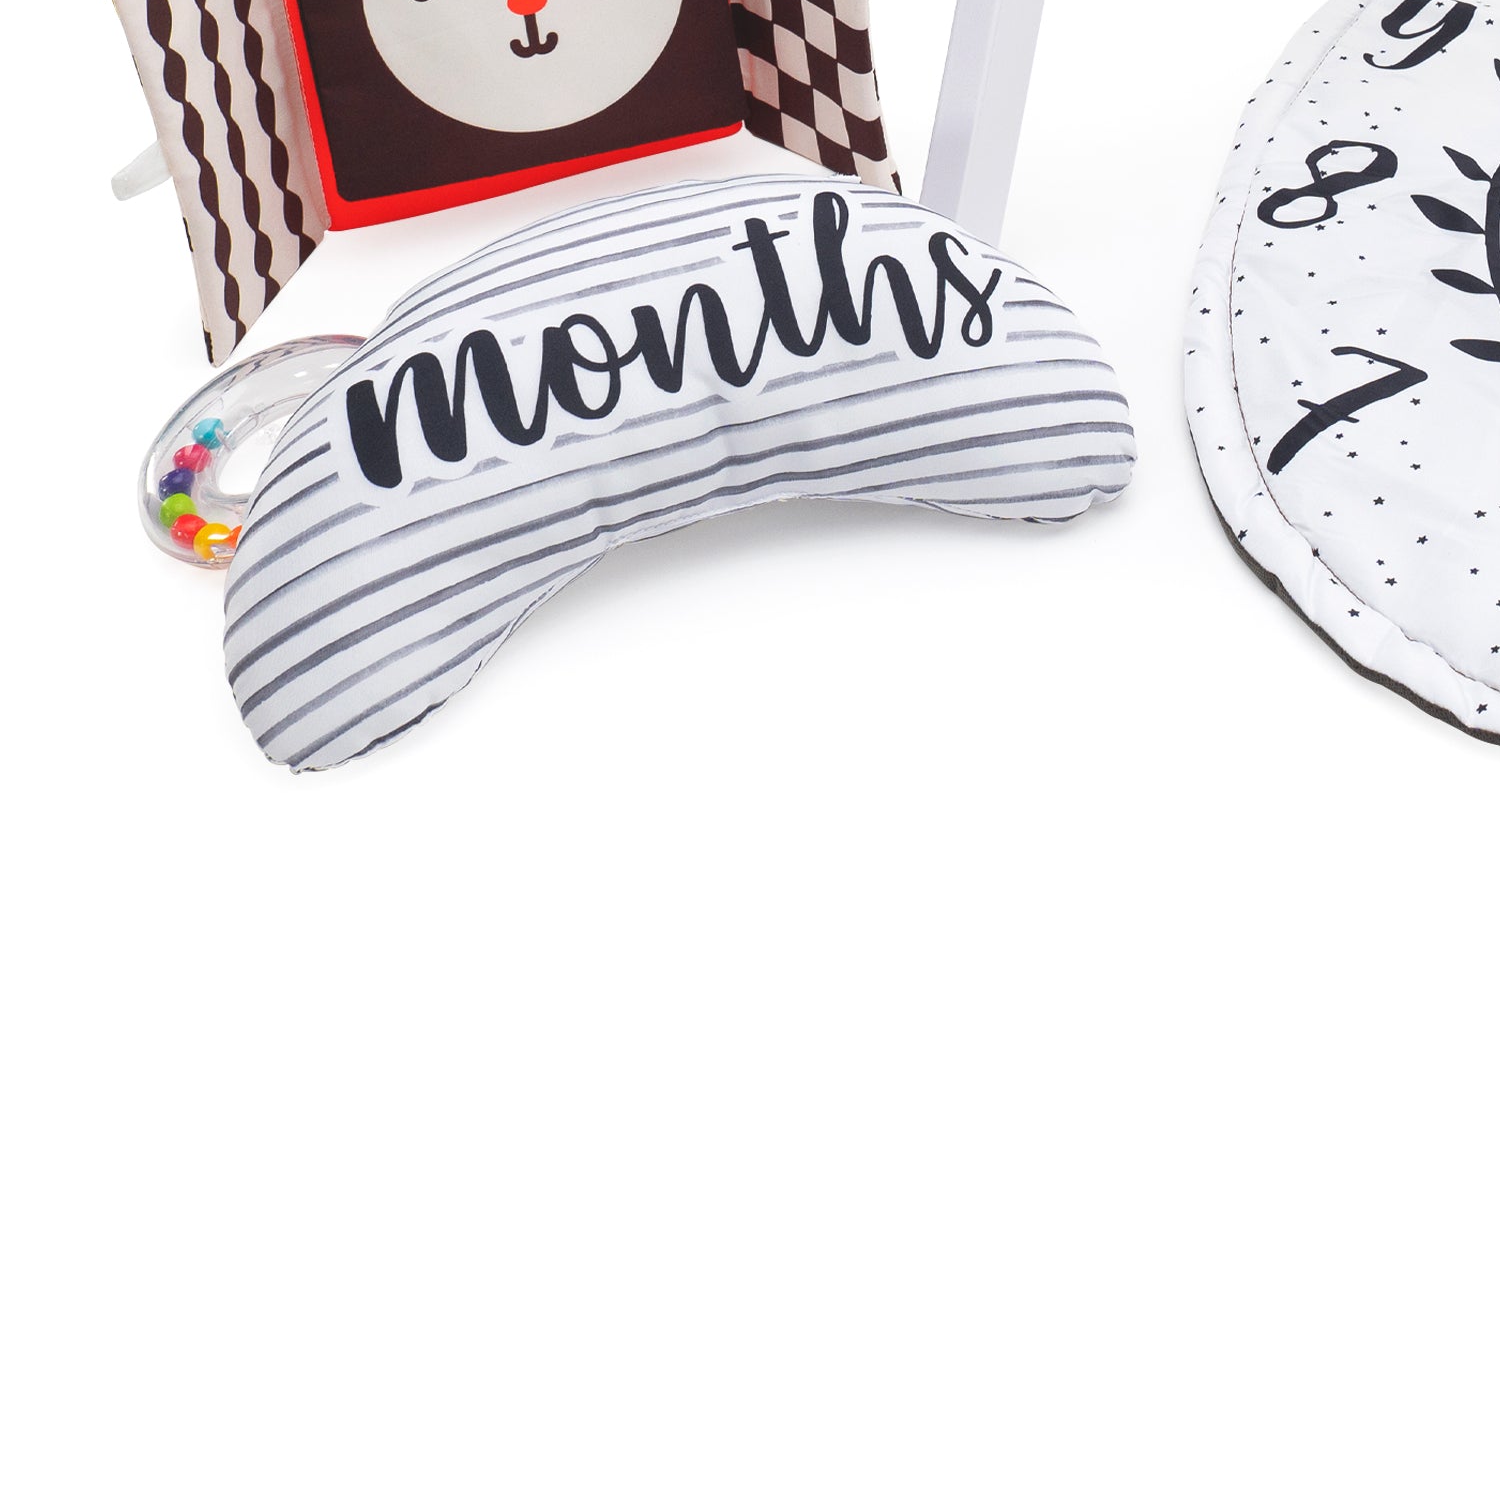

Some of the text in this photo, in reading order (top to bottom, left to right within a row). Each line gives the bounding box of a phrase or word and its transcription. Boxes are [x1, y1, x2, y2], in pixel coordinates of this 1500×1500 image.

[1257, 139, 1398, 229] 8
[346, 191, 1003, 489] months
[1266, 345, 1428, 476] 7
